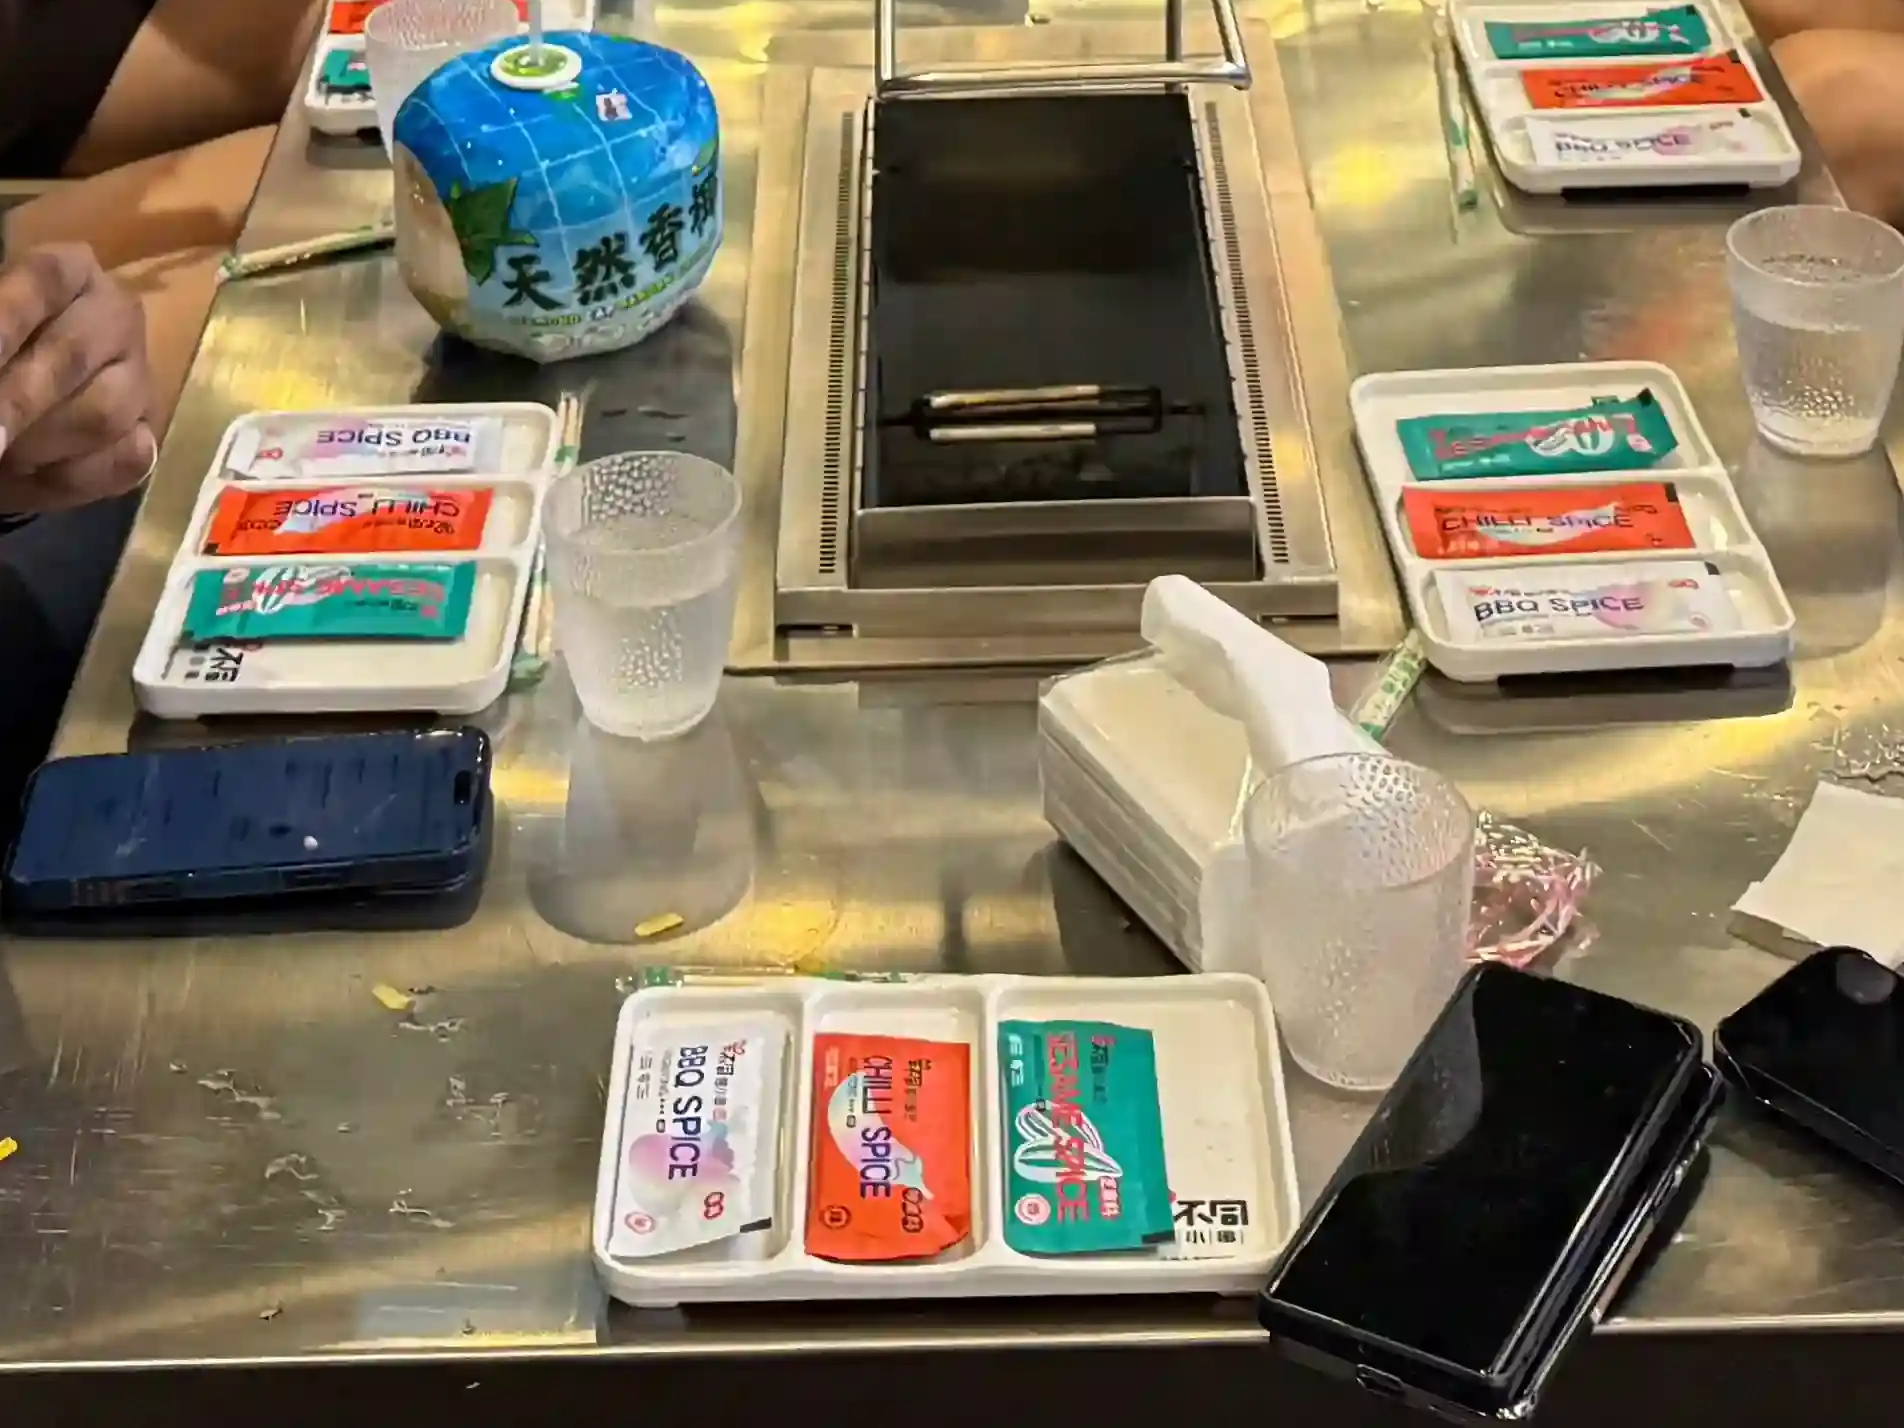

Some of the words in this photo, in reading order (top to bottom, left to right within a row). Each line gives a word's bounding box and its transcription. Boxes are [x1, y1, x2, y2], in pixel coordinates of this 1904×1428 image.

[316, 428, 402, 447] SPICE
[273, 498, 357, 518] SPICE
[1473, 598, 1542, 622] BBQ
[1548, 596, 1646, 618] SPICE
[672, 1045, 710, 1088] BBQ
[667, 1095, 703, 1181] SPICE
[859, 1126, 892, 1200] SPICE
[1172, 1199, 1249, 1226] 不同
